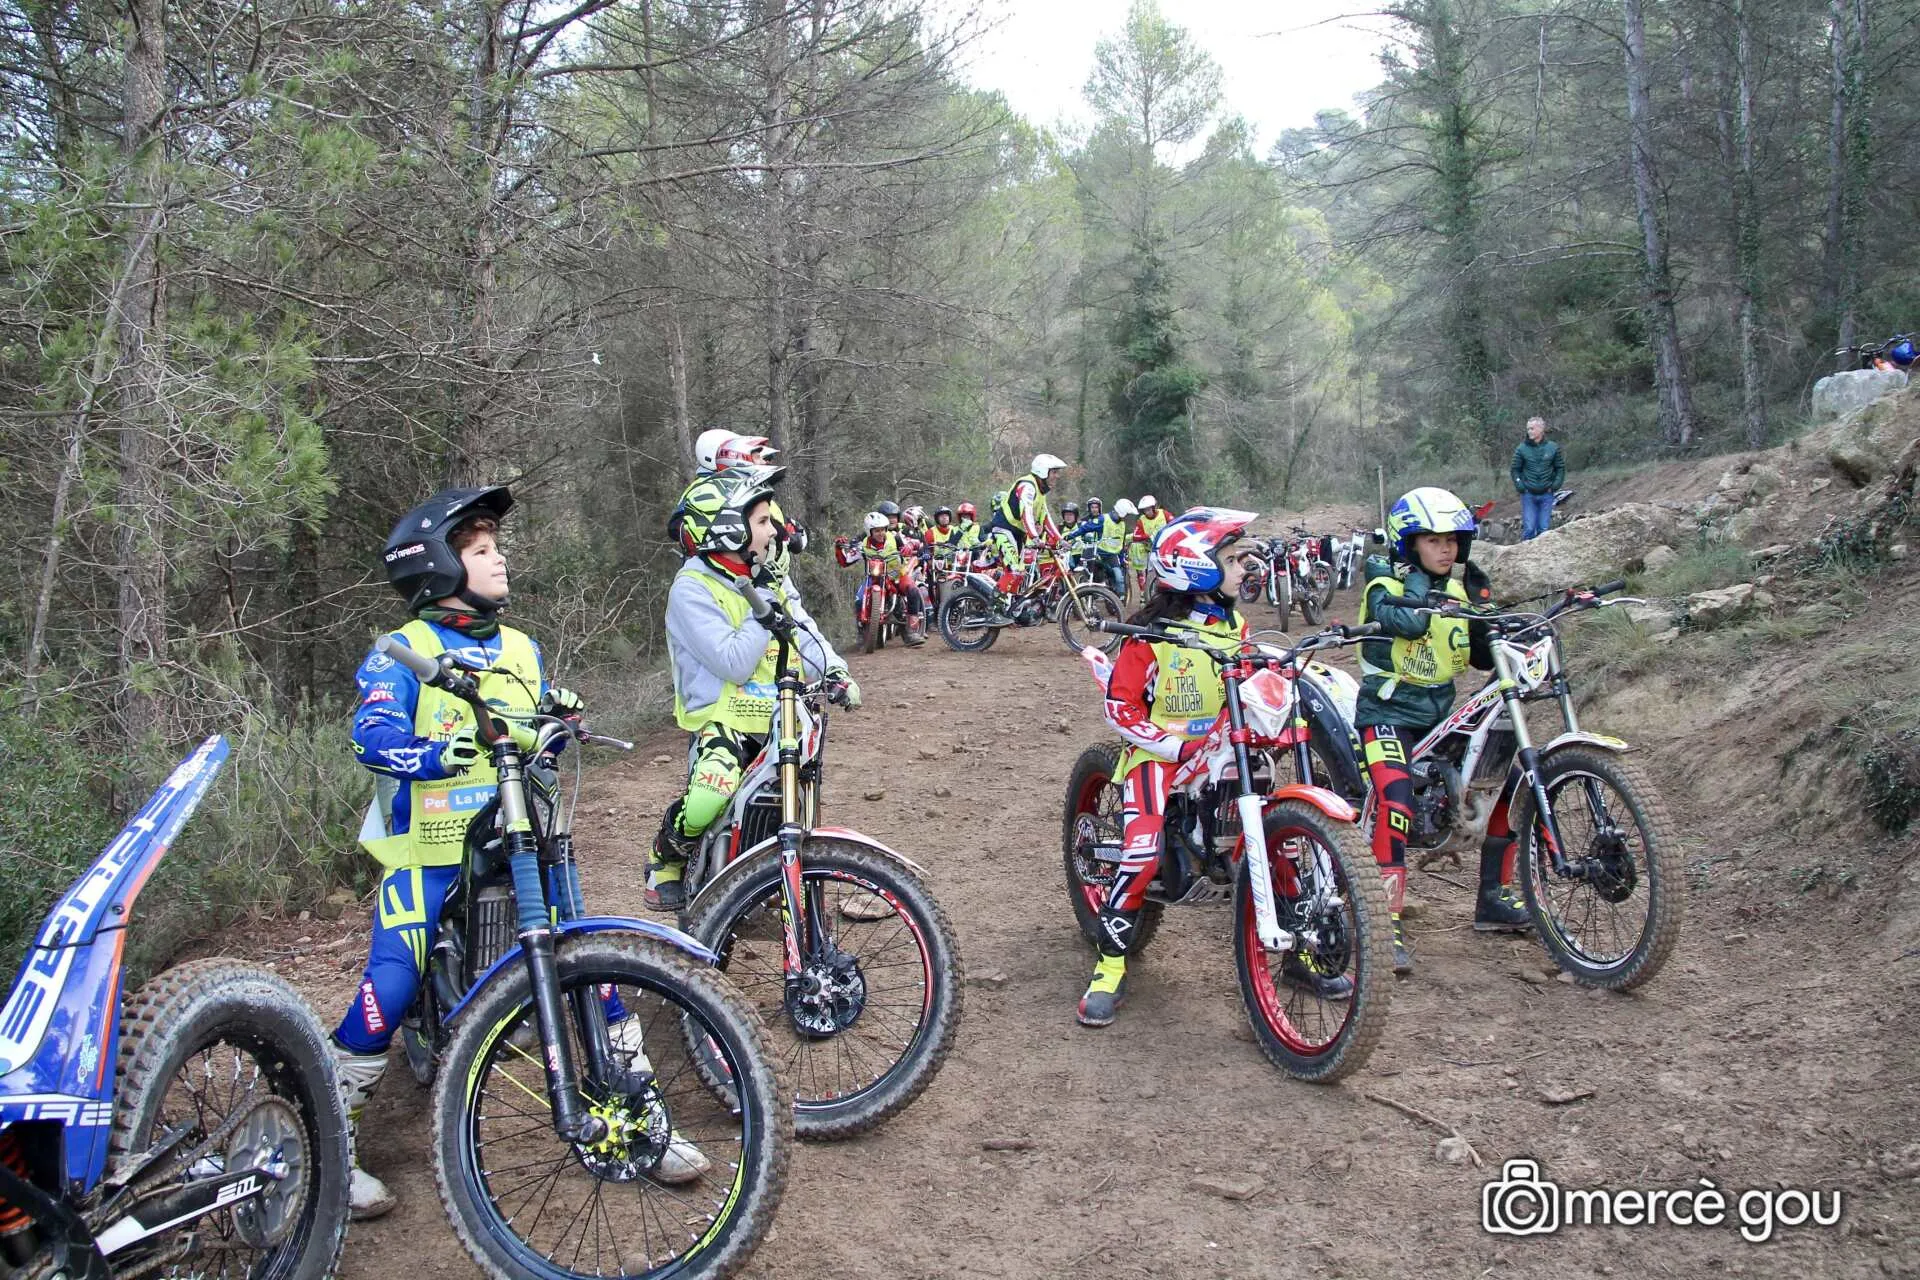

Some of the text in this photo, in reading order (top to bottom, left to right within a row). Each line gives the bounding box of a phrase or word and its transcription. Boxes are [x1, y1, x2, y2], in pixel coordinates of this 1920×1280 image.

[1166, 677, 1172, 694] 4
[424, 798, 447, 809] Per
[455, 795, 473, 806] La
